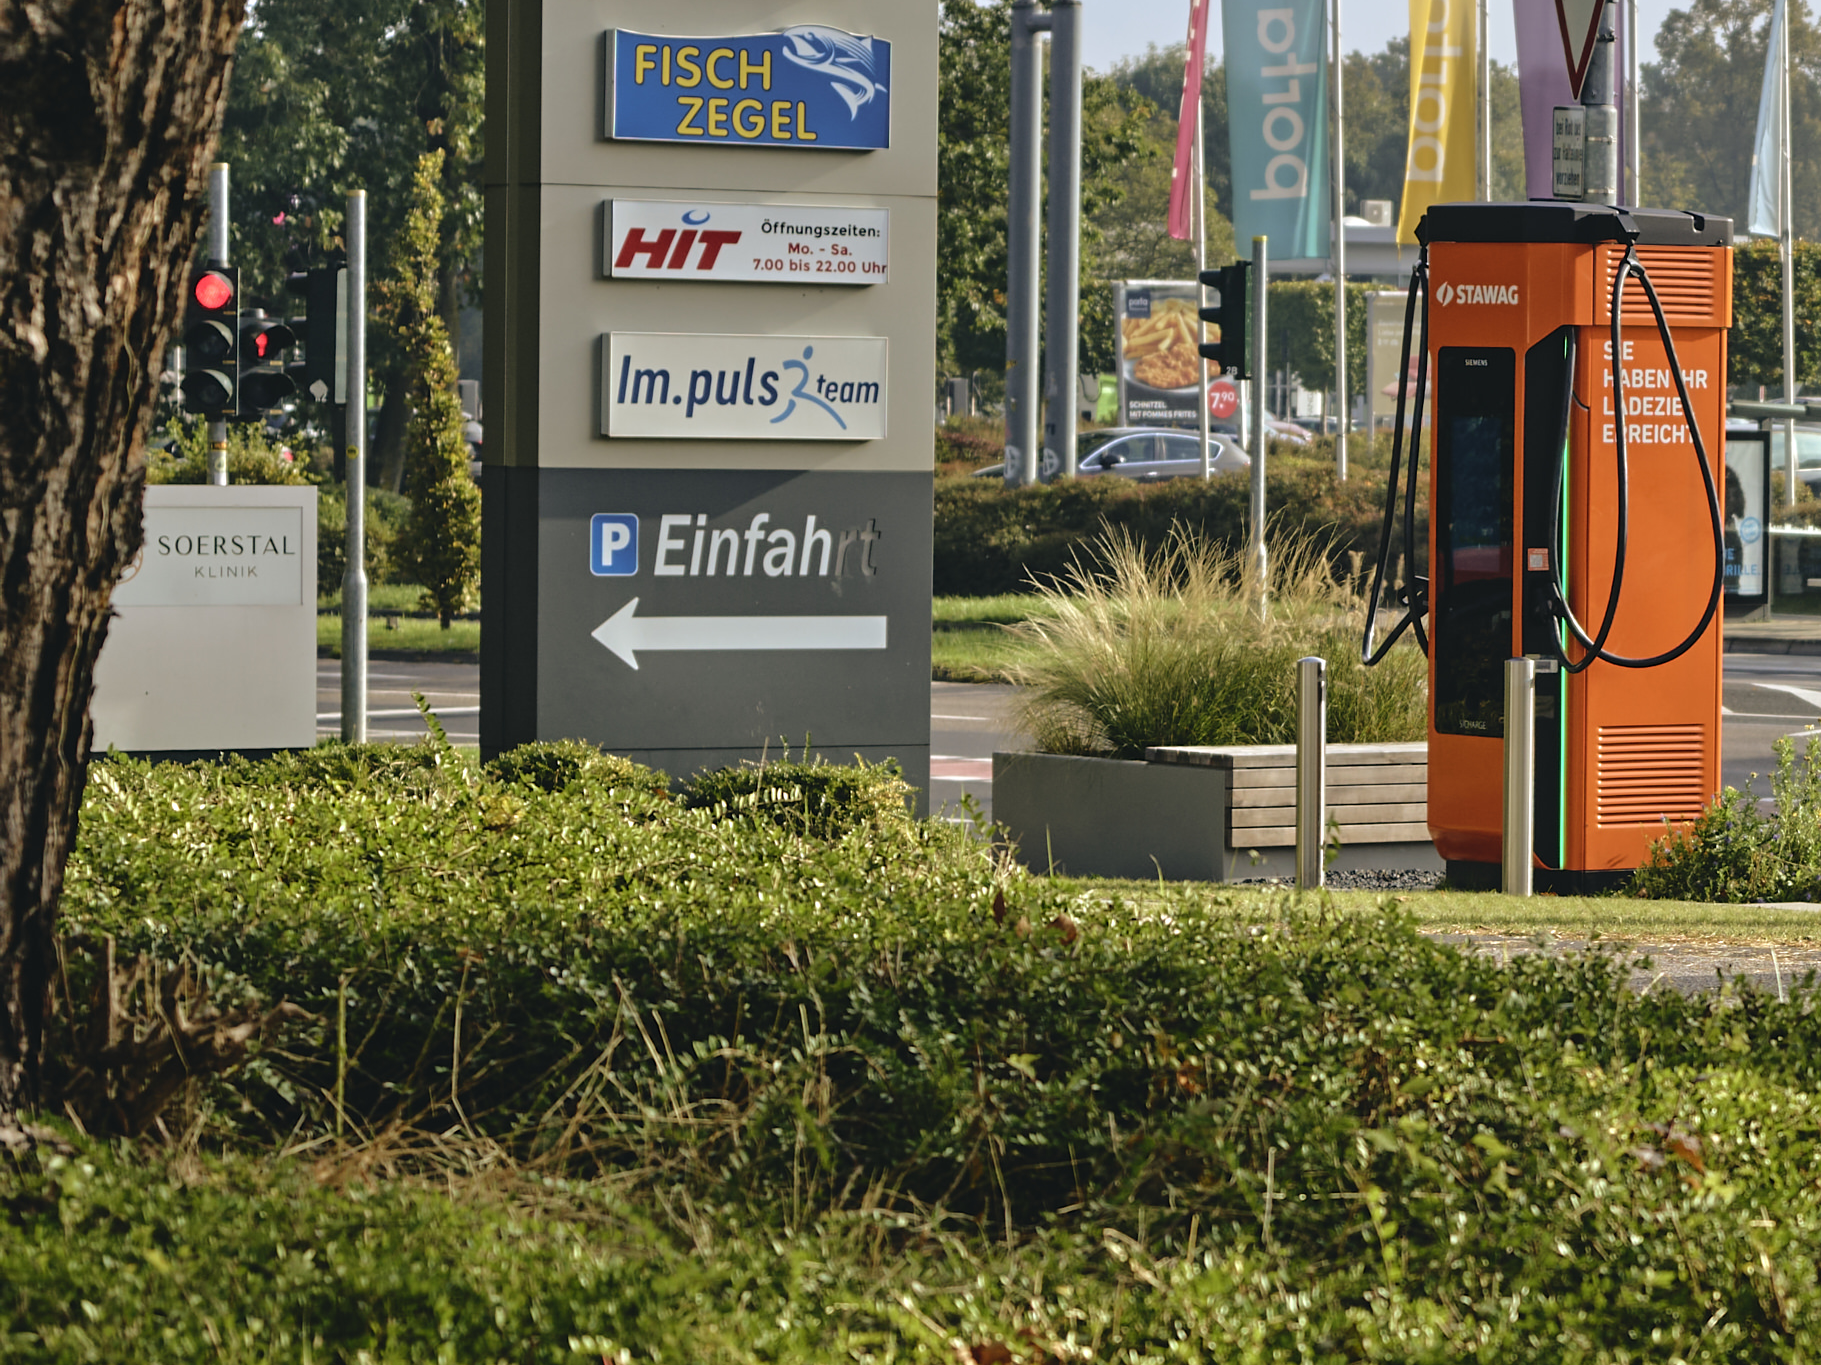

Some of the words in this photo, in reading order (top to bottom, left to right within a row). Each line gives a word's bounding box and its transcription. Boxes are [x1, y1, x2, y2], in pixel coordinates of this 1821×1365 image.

[634, 44, 772, 91] FISCH
[676, 96, 817, 141] ZEGEL
[761, 219, 880, 238] Öffnungszeiten:
[614, 227, 742, 270] HIT
[788, 242, 813, 255] Mo.
[831, 244, 852, 256] Sa.
[753, 258, 783, 271] 7.00
[789, 259, 810, 272] bis
[816, 260, 856, 273] 22.00
[862, 261, 887, 274] Uhr
[1456, 284, 1519, 305] STAWAG
[1603, 340, 1634, 360] SE
[1465, 359, 1488, 367] SIEMENS
[617, 355, 779, 418] Im.puls
[816, 374, 879, 403] team
[1680, 369, 1708, 389] HR
[1129, 400, 1167, 410] SCHNITZEL
[1129, 410, 1141, 419] MIT
[1174, 410, 1197, 419] FRITES
[1603, 396, 1684, 416] LDEZIE
[1602, 423, 1694, 444] EREICH
[157, 535, 296, 556] SOERSTAL
[601, 522, 631, 567] P
[653, 512, 882, 577] Einfahrt
[194, 565, 258, 578] KLINIK
